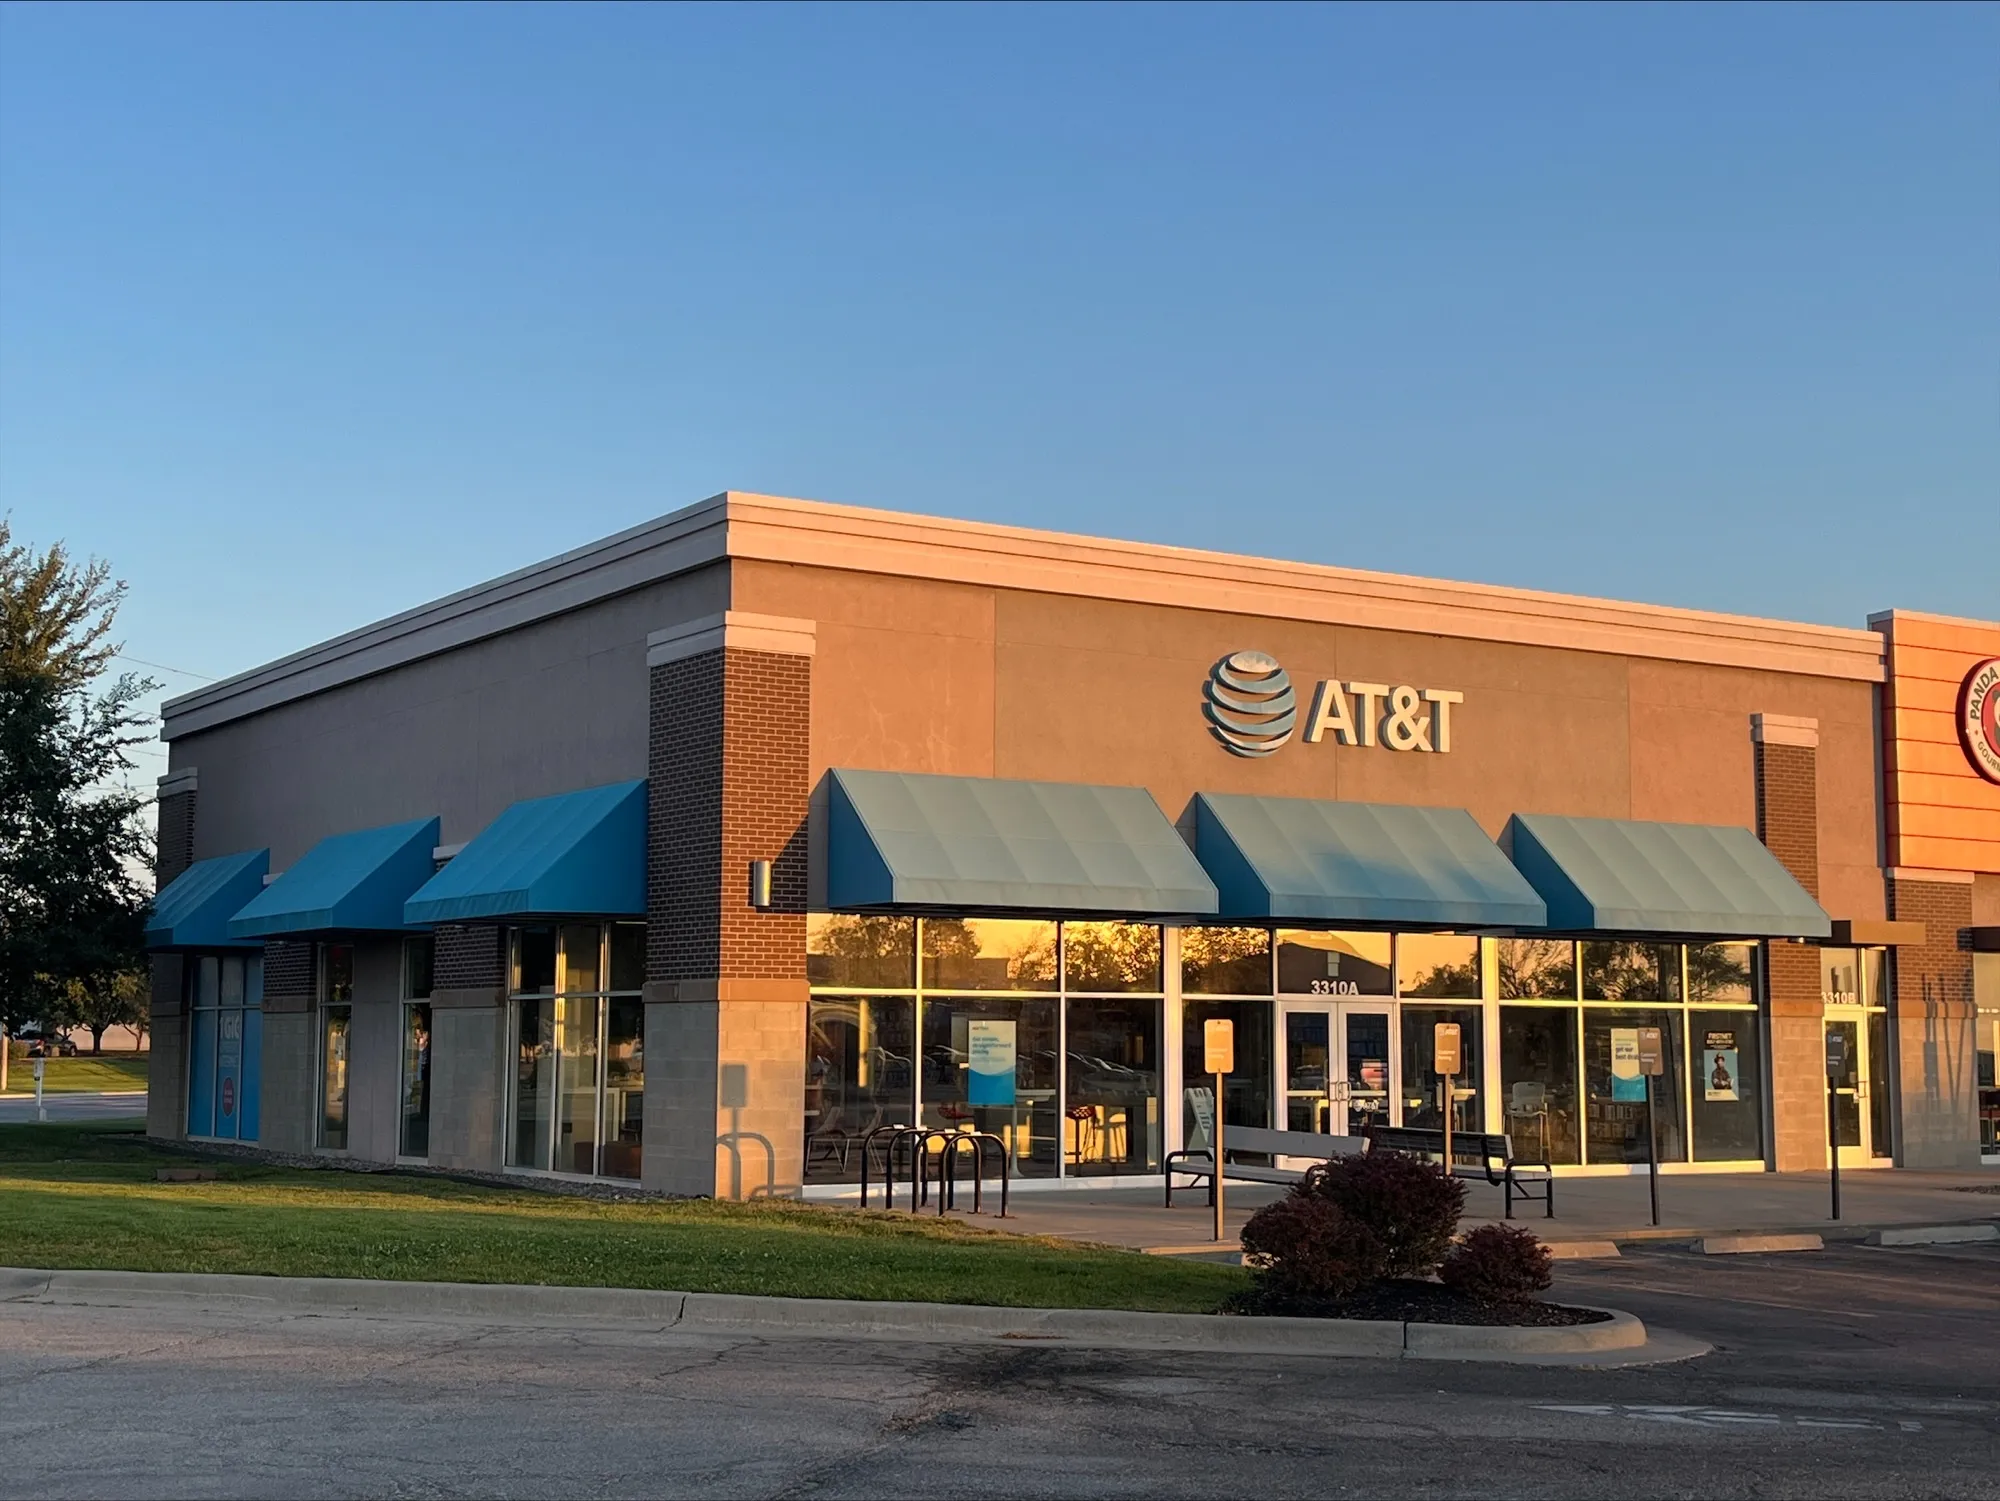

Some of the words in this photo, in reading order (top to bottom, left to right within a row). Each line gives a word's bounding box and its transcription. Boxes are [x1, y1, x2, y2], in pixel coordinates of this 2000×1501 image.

[1970, 667, 1999, 720] PANDA
[1303, 680, 1463, 752] AT&T
[1310, 980, 1359, 995] 3310A
[1821, 992, 1856, 1004] 3310B
